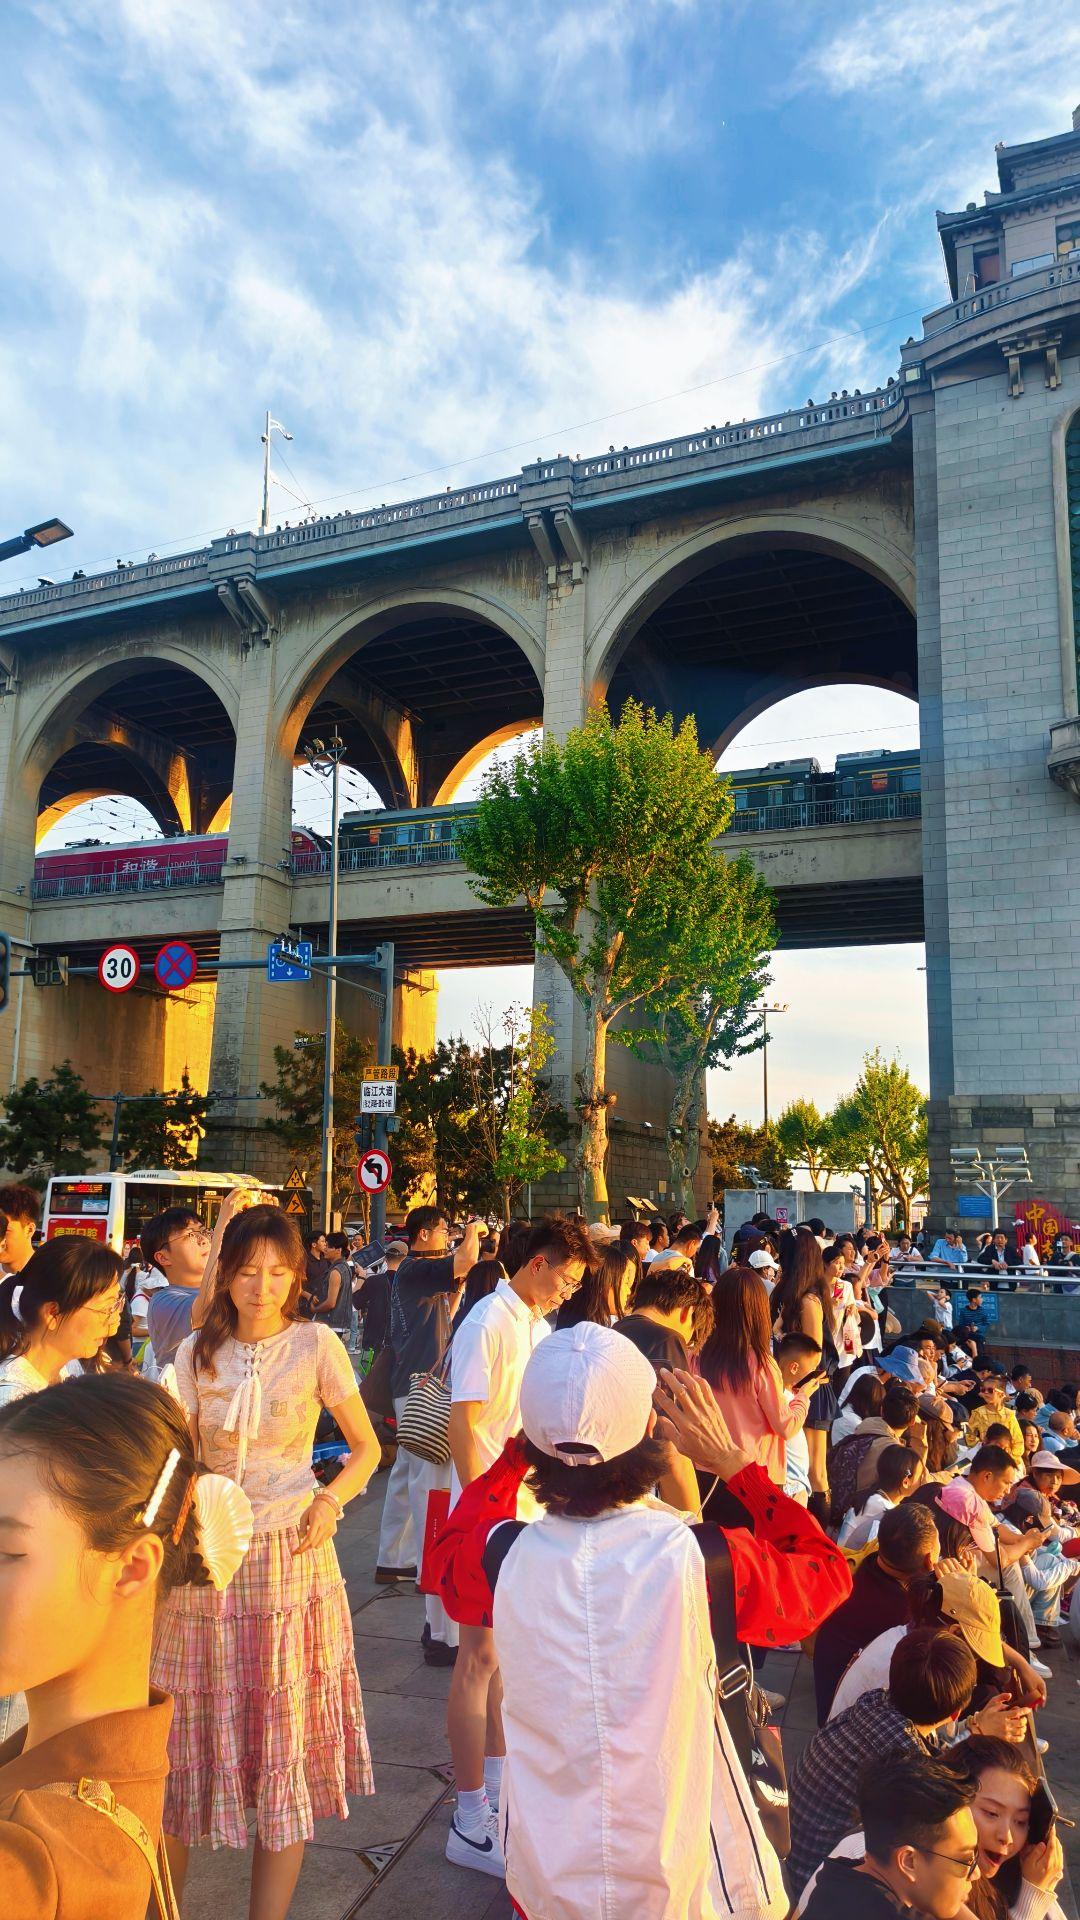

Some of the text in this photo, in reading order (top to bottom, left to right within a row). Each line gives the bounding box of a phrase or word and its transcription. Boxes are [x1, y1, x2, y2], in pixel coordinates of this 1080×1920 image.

[122, 859, 159, 874] 和谐
[106, 957, 132, 979] 30
[365, 1067, 396, 1080] 严管路段
[363, 1086, 394, 1097] 临江大道
